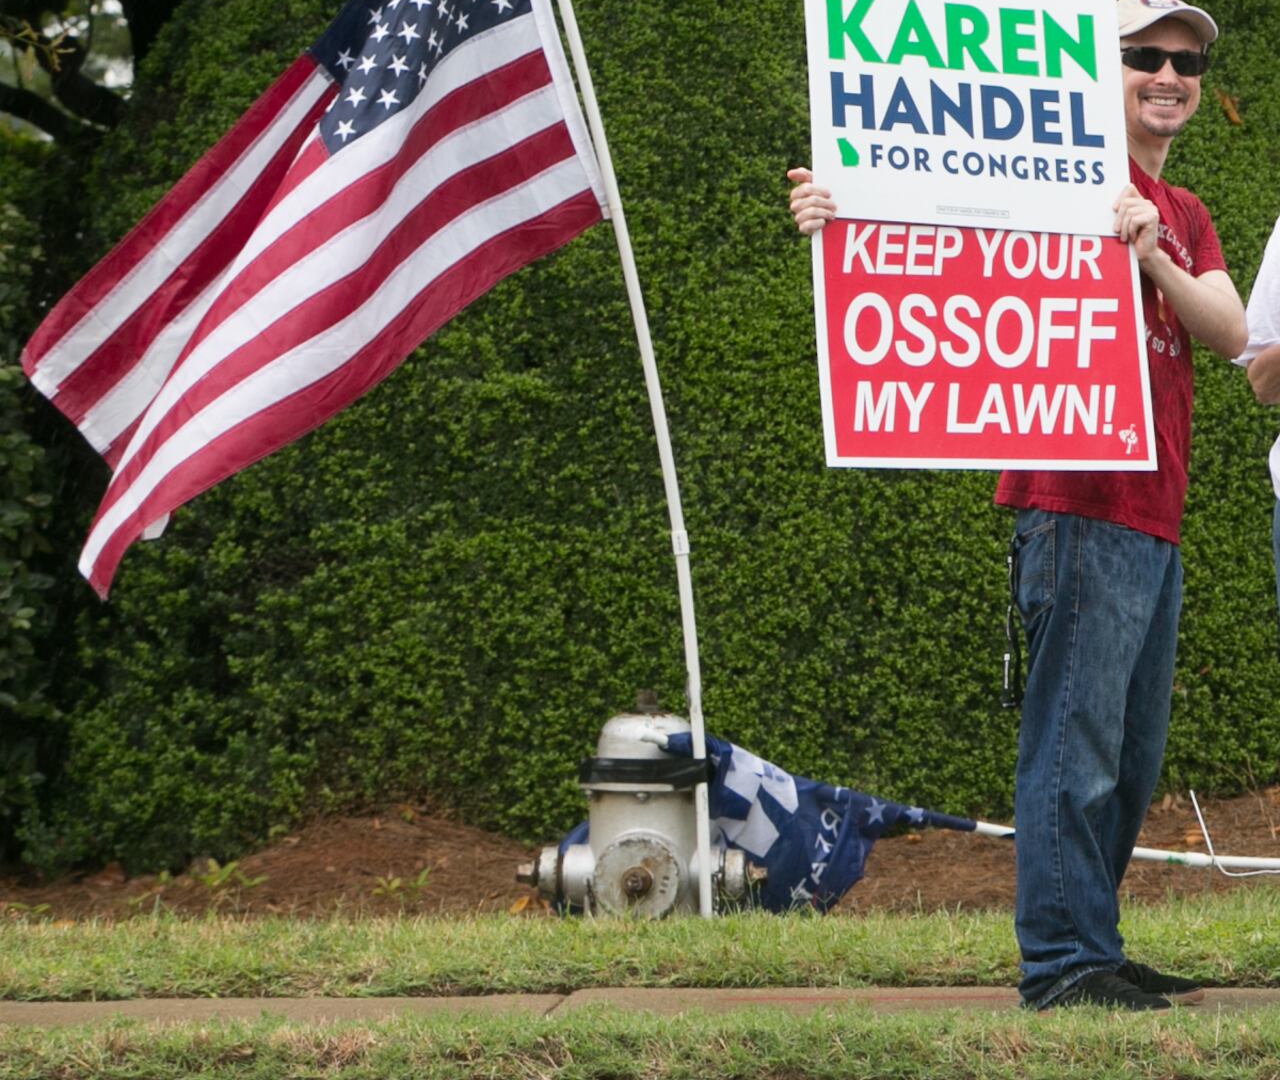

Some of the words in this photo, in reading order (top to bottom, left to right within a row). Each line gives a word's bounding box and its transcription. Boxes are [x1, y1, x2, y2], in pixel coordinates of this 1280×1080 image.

[831, 71, 1105, 149] HANDEL
[870, 144, 932, 172] FOR
[942, 150, 1105, 185] CONGRESS
[842, 224, 964, 277] KEEP
[976, 233, 1103, 281] YOUR
[843, 292, 1119, 369] OSSOFF
[853, 380, 936, 433] MY
[945, 383, 1117, 436] LAWN!
